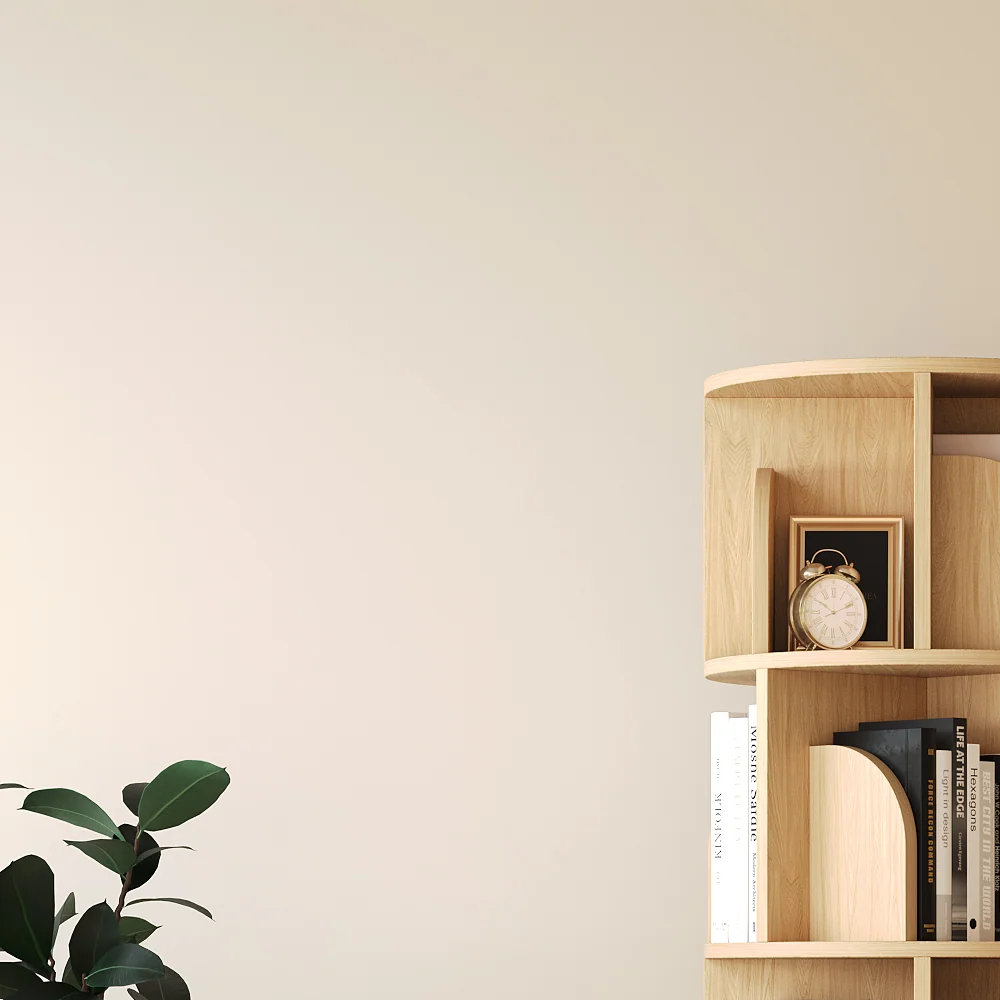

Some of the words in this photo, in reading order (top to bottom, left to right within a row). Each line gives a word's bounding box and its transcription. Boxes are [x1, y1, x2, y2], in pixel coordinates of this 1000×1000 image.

[956, 725, 965, 748] LIFE
[956, 750, 965, 764] AT
[941, 769, 949, 795] Light
[956, 766, 965, 787] THE
[982, 771, 991, 803] BEST
[943, 799, 949, 808] in
[956, 789, 965, 818] EDGE
[969, 768, 978, 831] Hexagons
[941, 813, 949, 848] design
[982, 806, 991, 835] CITY
[982, 840, 991, 853] IN
[982, 857, 991, 882] THE
[982, 885, 991, 930] WORLD
